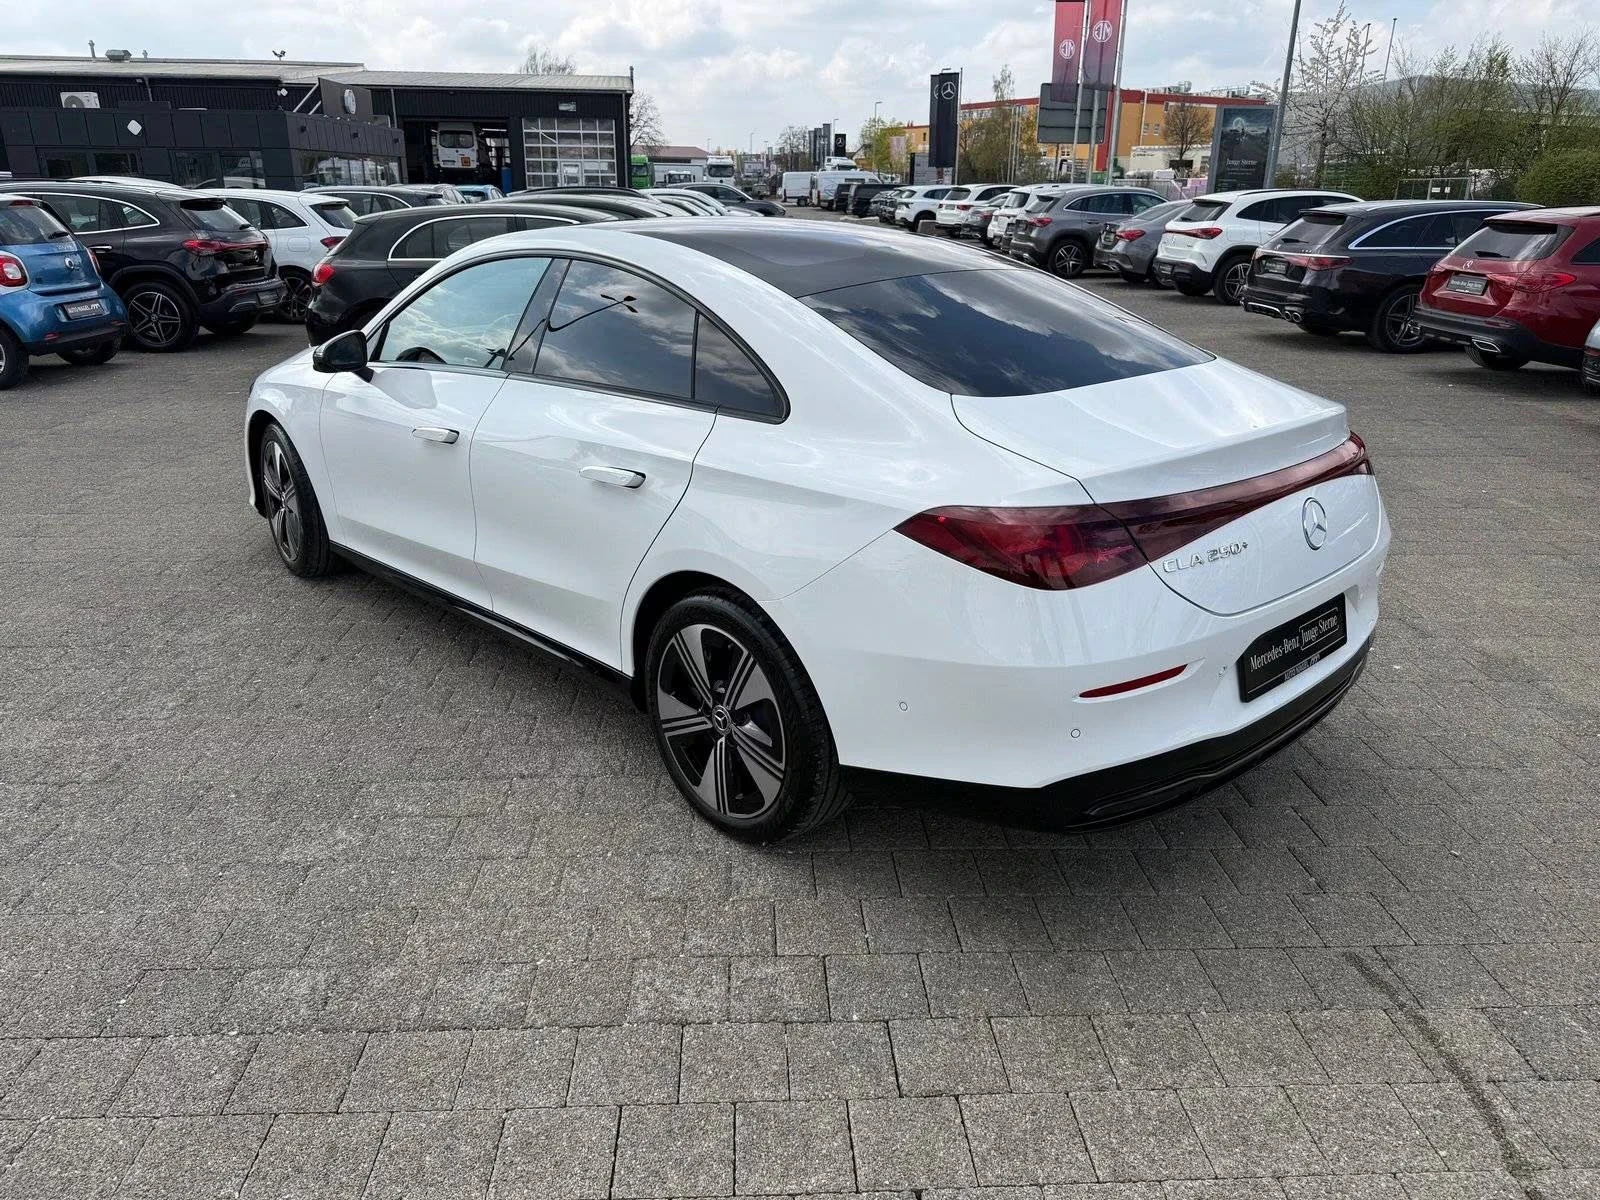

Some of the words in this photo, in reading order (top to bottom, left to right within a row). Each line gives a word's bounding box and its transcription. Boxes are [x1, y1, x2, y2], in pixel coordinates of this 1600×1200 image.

[1162, 552, 1205, 573] CLA
[1206, 541, 1249, 563] 250+
[1250, 635, 1300, 673] Mercedes-Benz
[1300, 625, 1318, 647] Junge
[1318, 614, 1339, 632] Sterne
